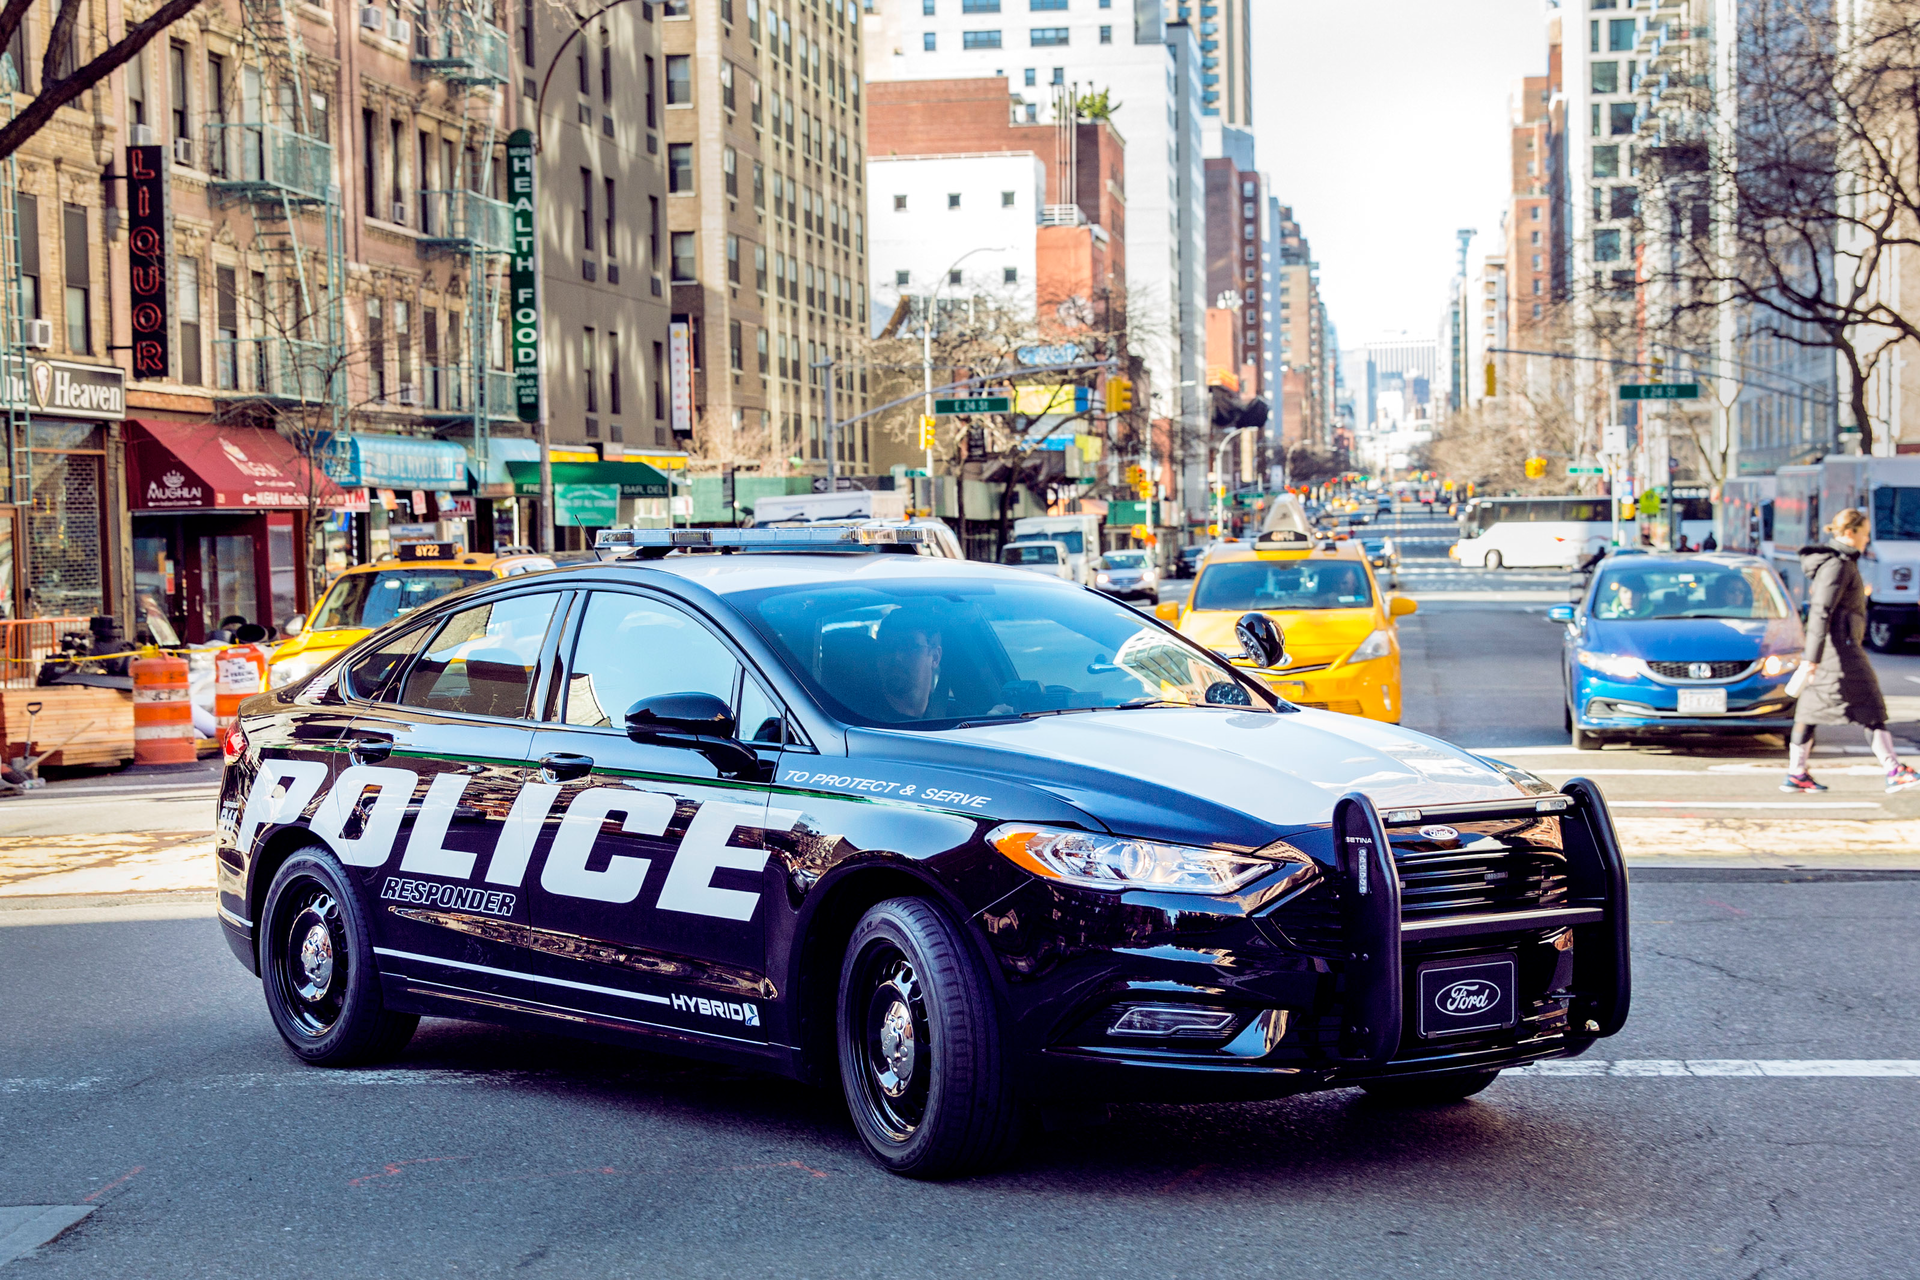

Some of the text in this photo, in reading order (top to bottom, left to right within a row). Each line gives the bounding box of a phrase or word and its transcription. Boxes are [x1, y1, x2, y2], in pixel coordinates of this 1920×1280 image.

[513, 157, 534, 272] HEALTH
[130, 149, 163, 370] LIQUOR
[515, 288, 538, 364] FOOD
[54, 370, 122, 411] Heaven
[954, 401, 960, 412] E
[964, 400, 976, 411] 24
[147, 481, 202, 500] MUGHLAI
[784, 770, 992, 809] TO PROTECT & SERVE
[237, 759, 803, 921] POLICE
[380, 876, 517, 916] RESPONDER
[671, 993, 744, 1021] HYBRID
[1446, 984, 1490, 1011] Ford
